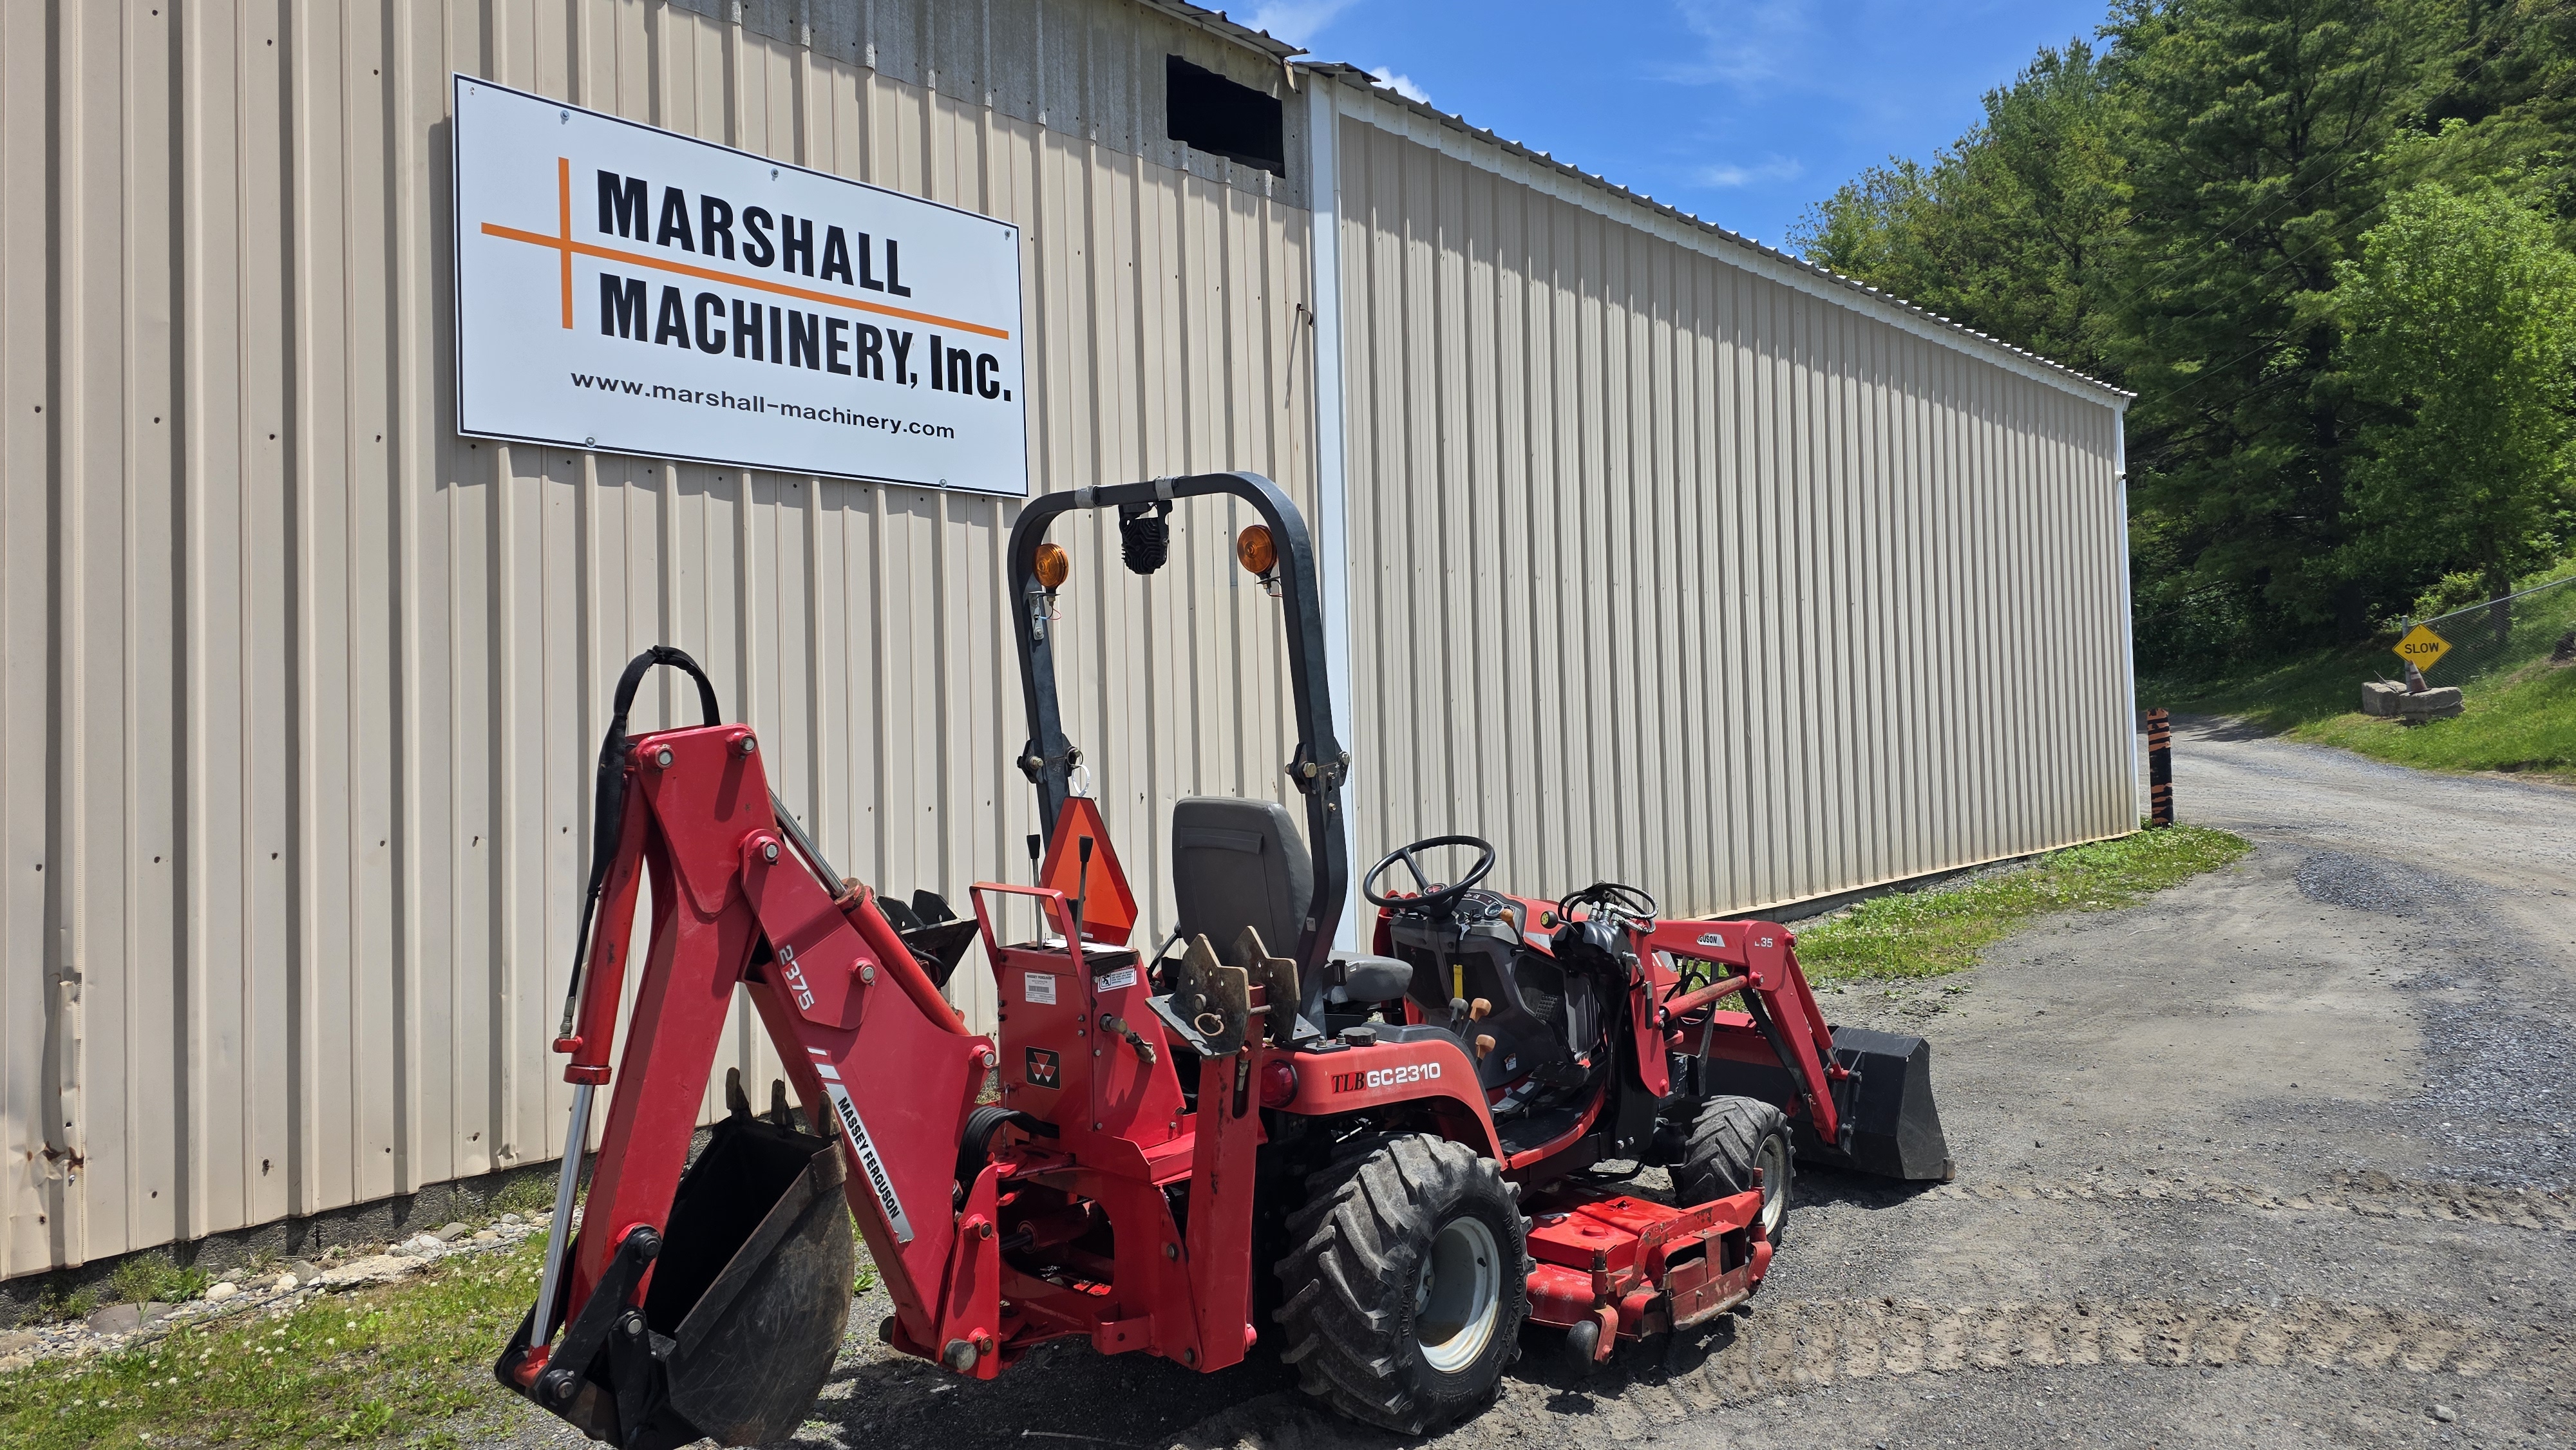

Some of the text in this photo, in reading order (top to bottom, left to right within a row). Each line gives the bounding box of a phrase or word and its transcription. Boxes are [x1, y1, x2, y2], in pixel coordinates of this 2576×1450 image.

[597, 169, 911, 298] MARSHALL
[600, 273, 1012, 402] MACHINERY, Inc.
[571, 373, 955, 439] www.marshall-machinery.com
[2404, 642, 2439, 654] SLOW
[1698, 935, 1718, 944] GUSON
[779, 944, 815, 1011] 2375
[1332, 1062, 1441, 1093] TLB GC2310
[838, 1097, 900, 1220] MASSEY FERGUSON
